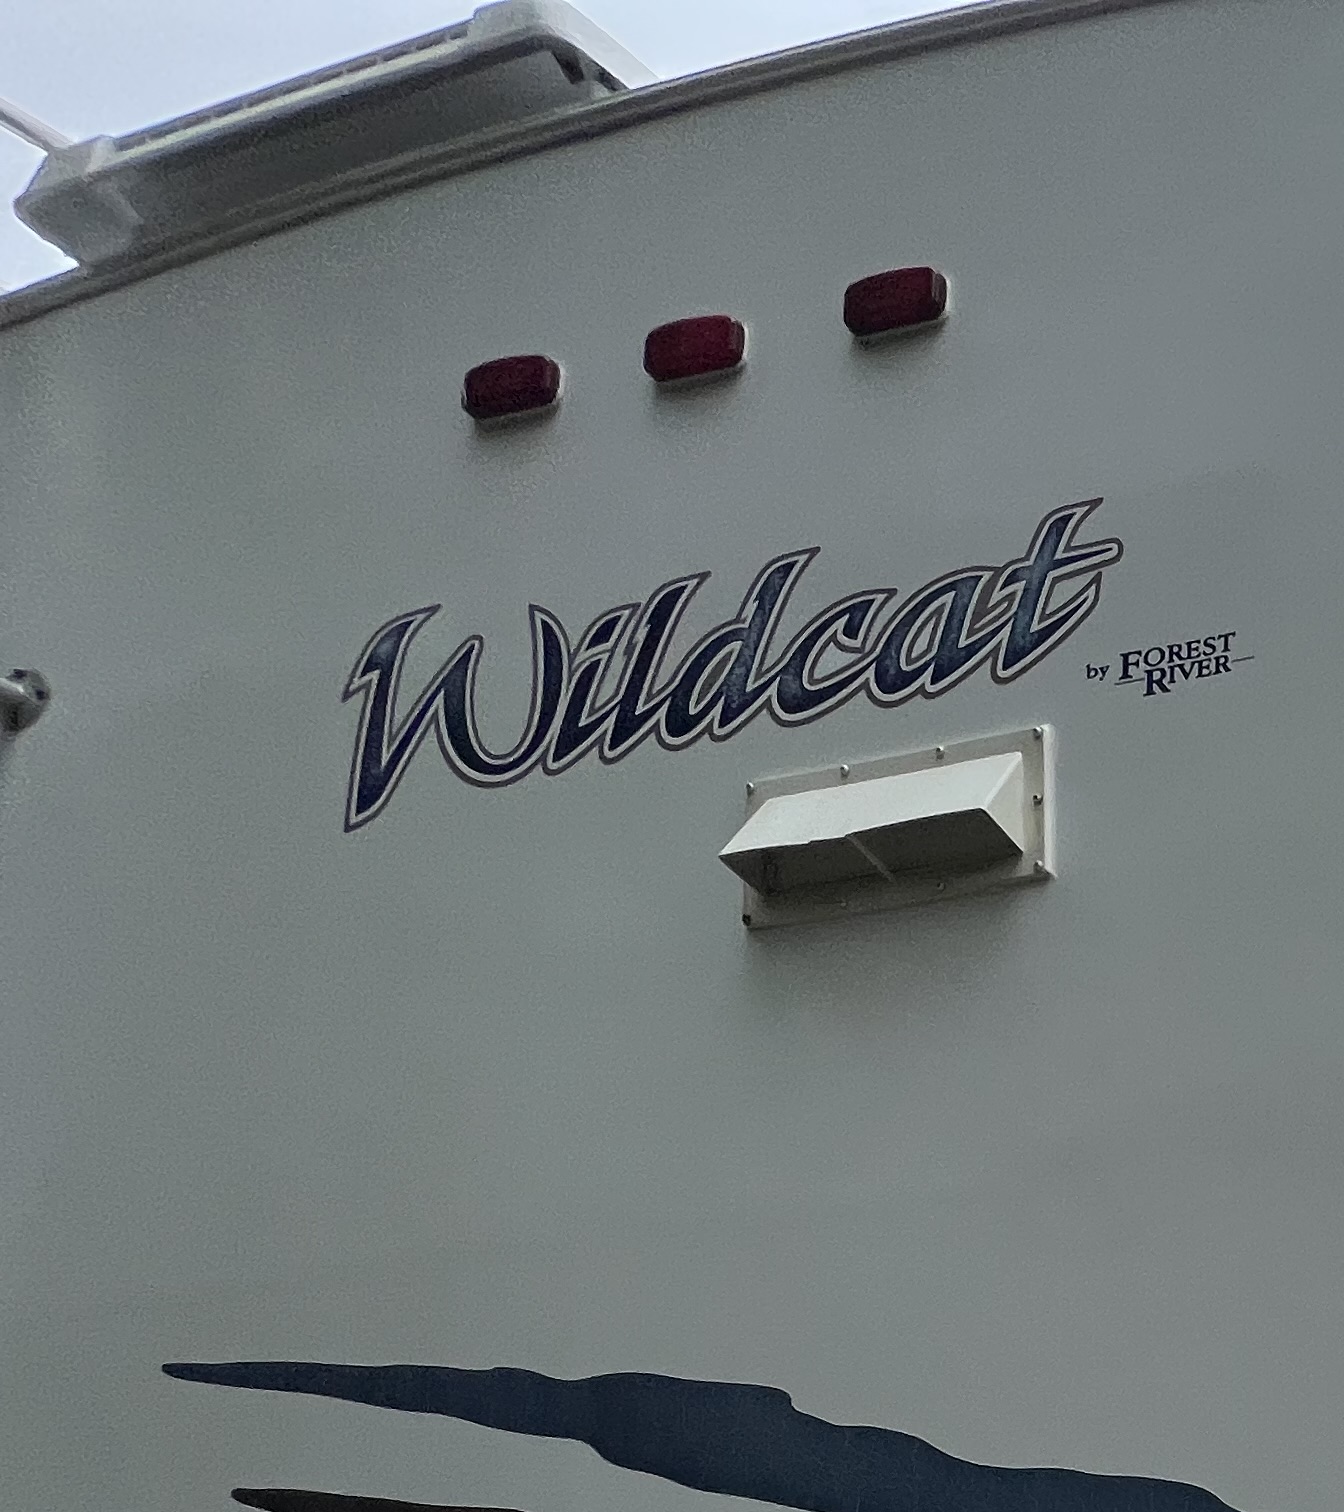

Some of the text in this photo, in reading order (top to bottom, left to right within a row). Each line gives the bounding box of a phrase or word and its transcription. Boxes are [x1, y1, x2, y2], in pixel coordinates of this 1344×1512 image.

[341, 497, 1124, 833] Wildcat
[1086, 631, 1236, 682] by FOREST
[1143, 654, 1232, 697] RIVER
